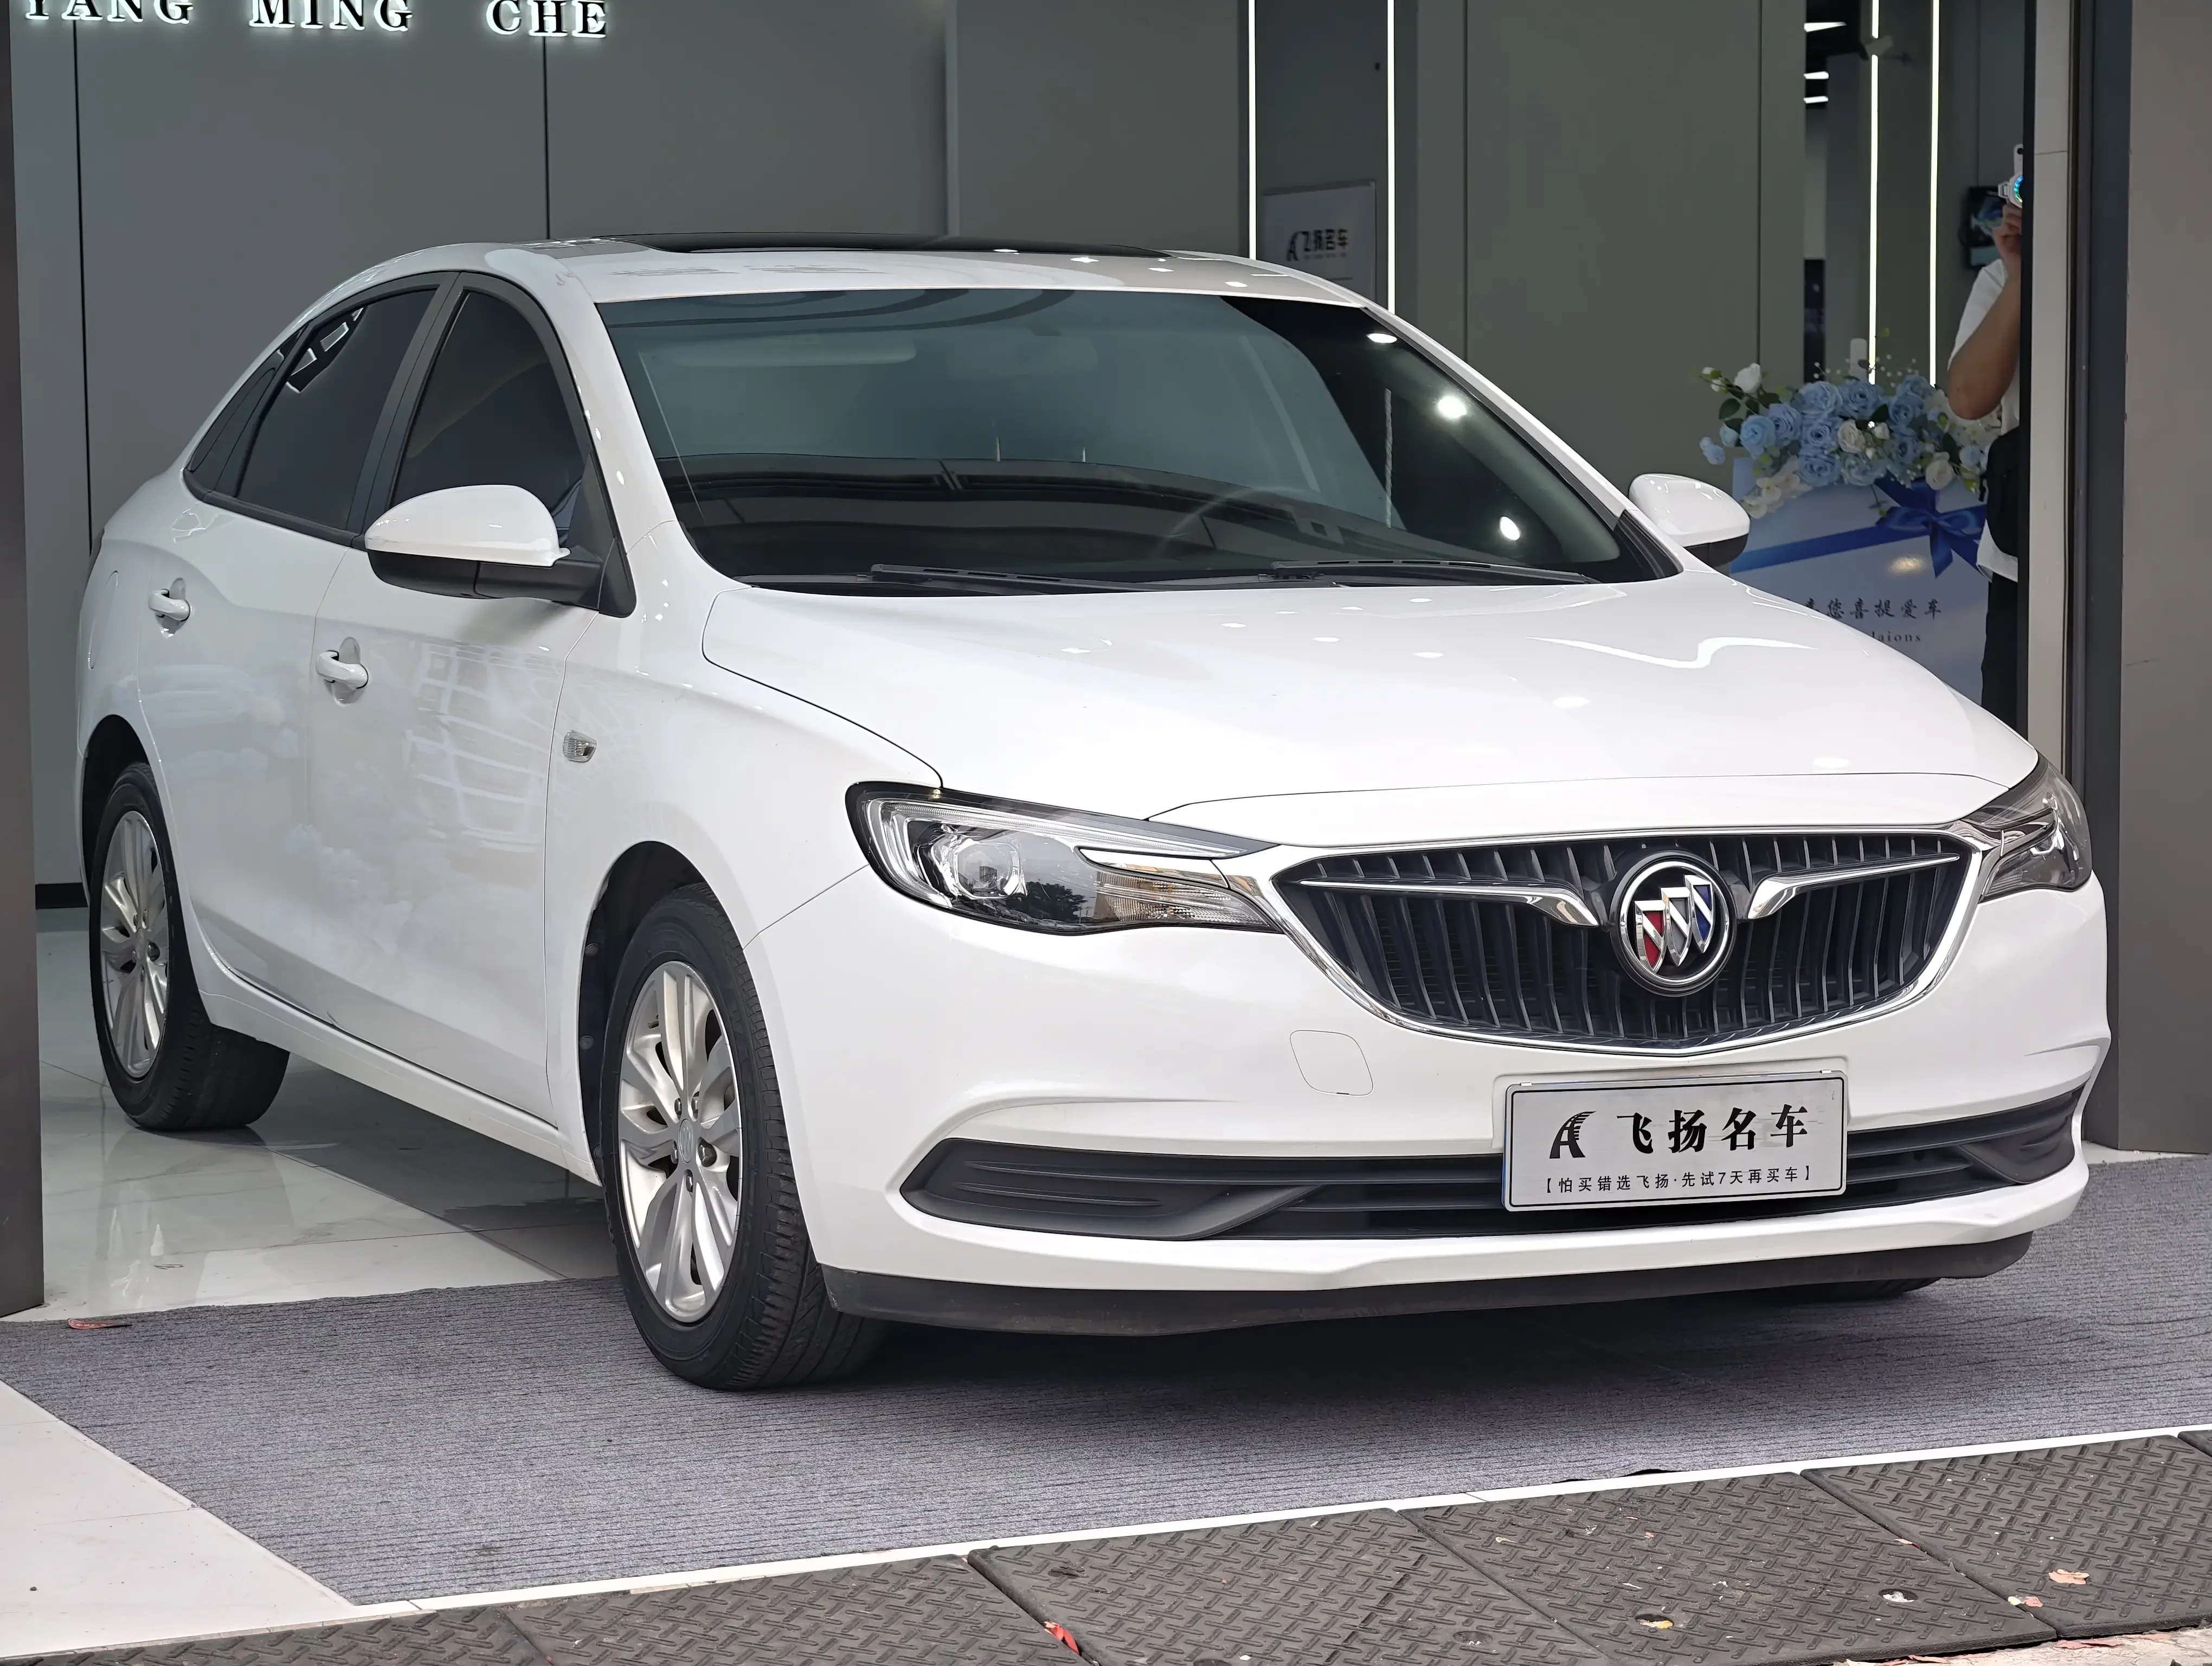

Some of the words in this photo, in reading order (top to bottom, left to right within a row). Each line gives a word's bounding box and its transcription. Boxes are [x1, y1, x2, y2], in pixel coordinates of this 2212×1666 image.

[249, 0, 413, 31] MING
[486, 0, 607, 38] CHE
[1616, 1104, 1809, 1155] 飞扬名车
